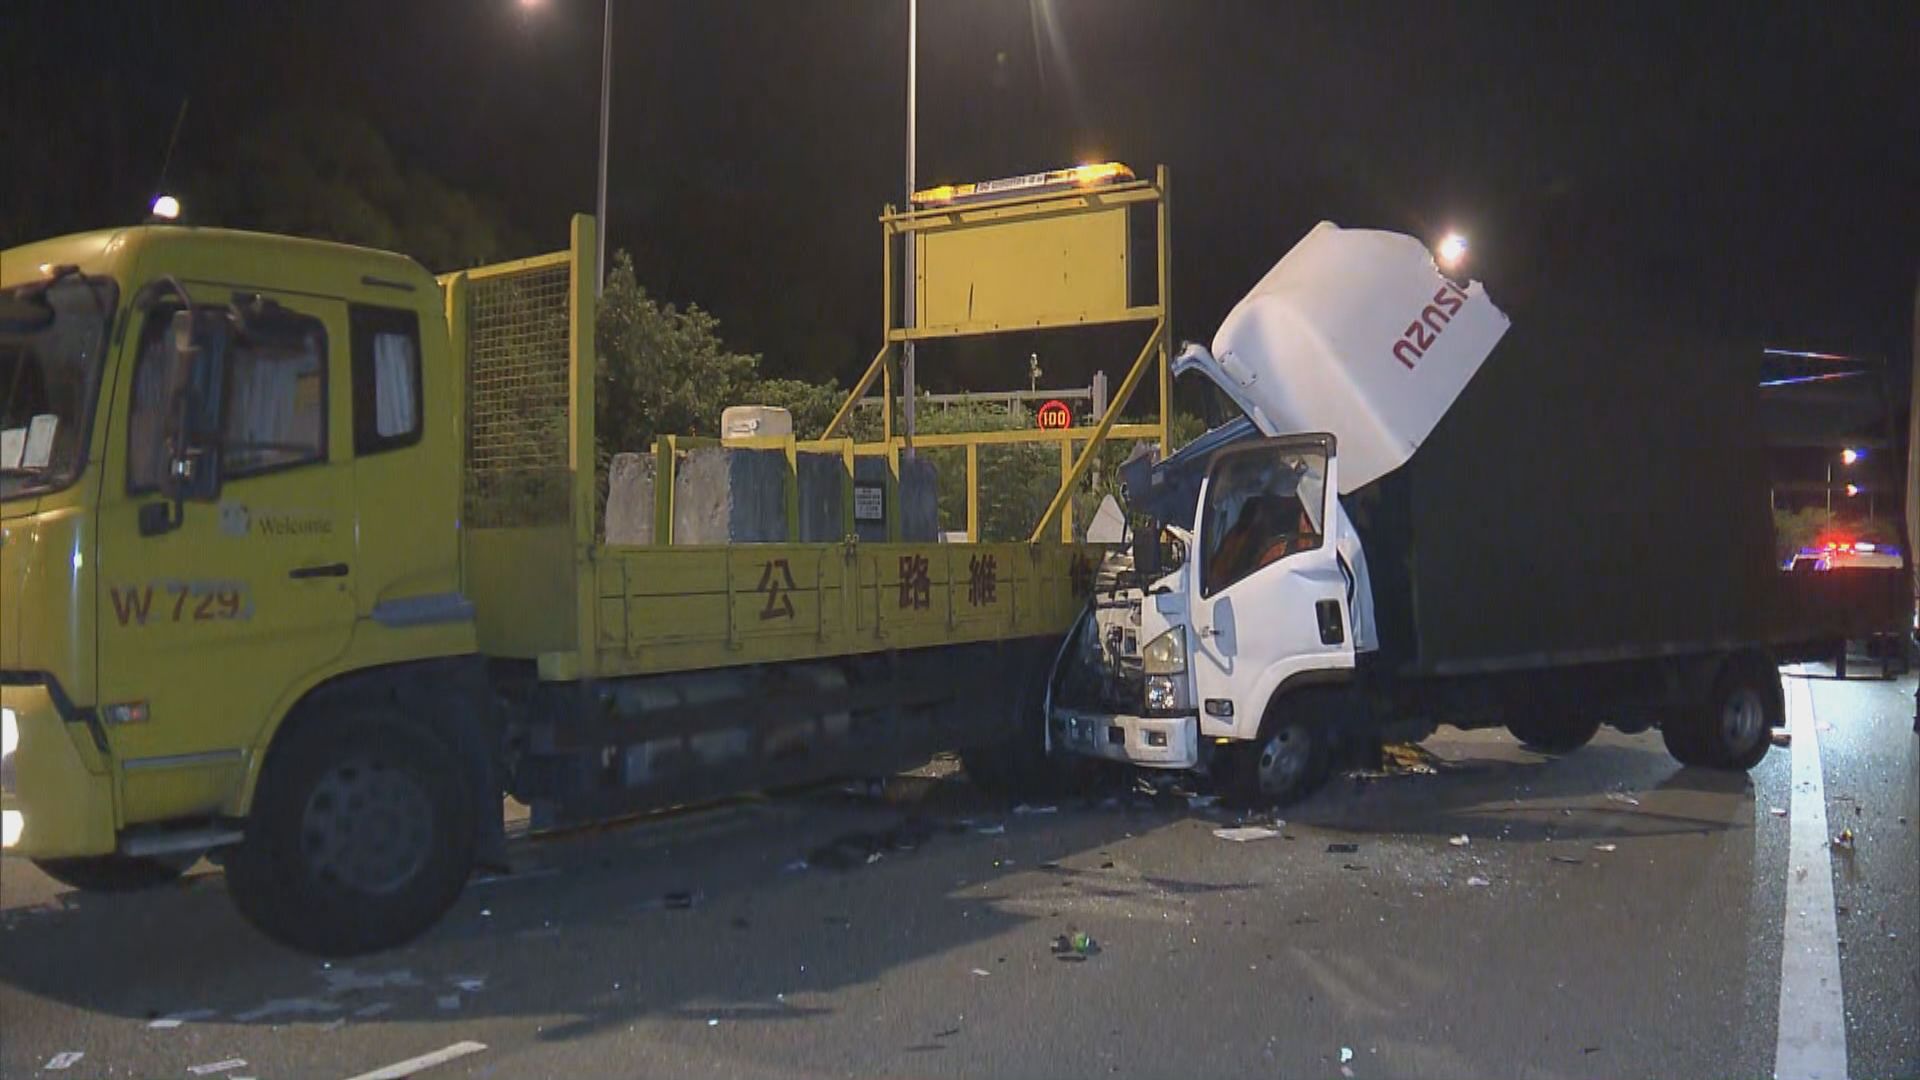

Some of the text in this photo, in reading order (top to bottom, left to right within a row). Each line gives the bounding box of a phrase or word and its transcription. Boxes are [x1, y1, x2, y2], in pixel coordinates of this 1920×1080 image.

[1393, 282, 1468, 370] ISUZU
[1044, 411, 1066, 426] 100
[258, 515, 333, 536] Welcome
[110, 579, 241, 627] W 729
